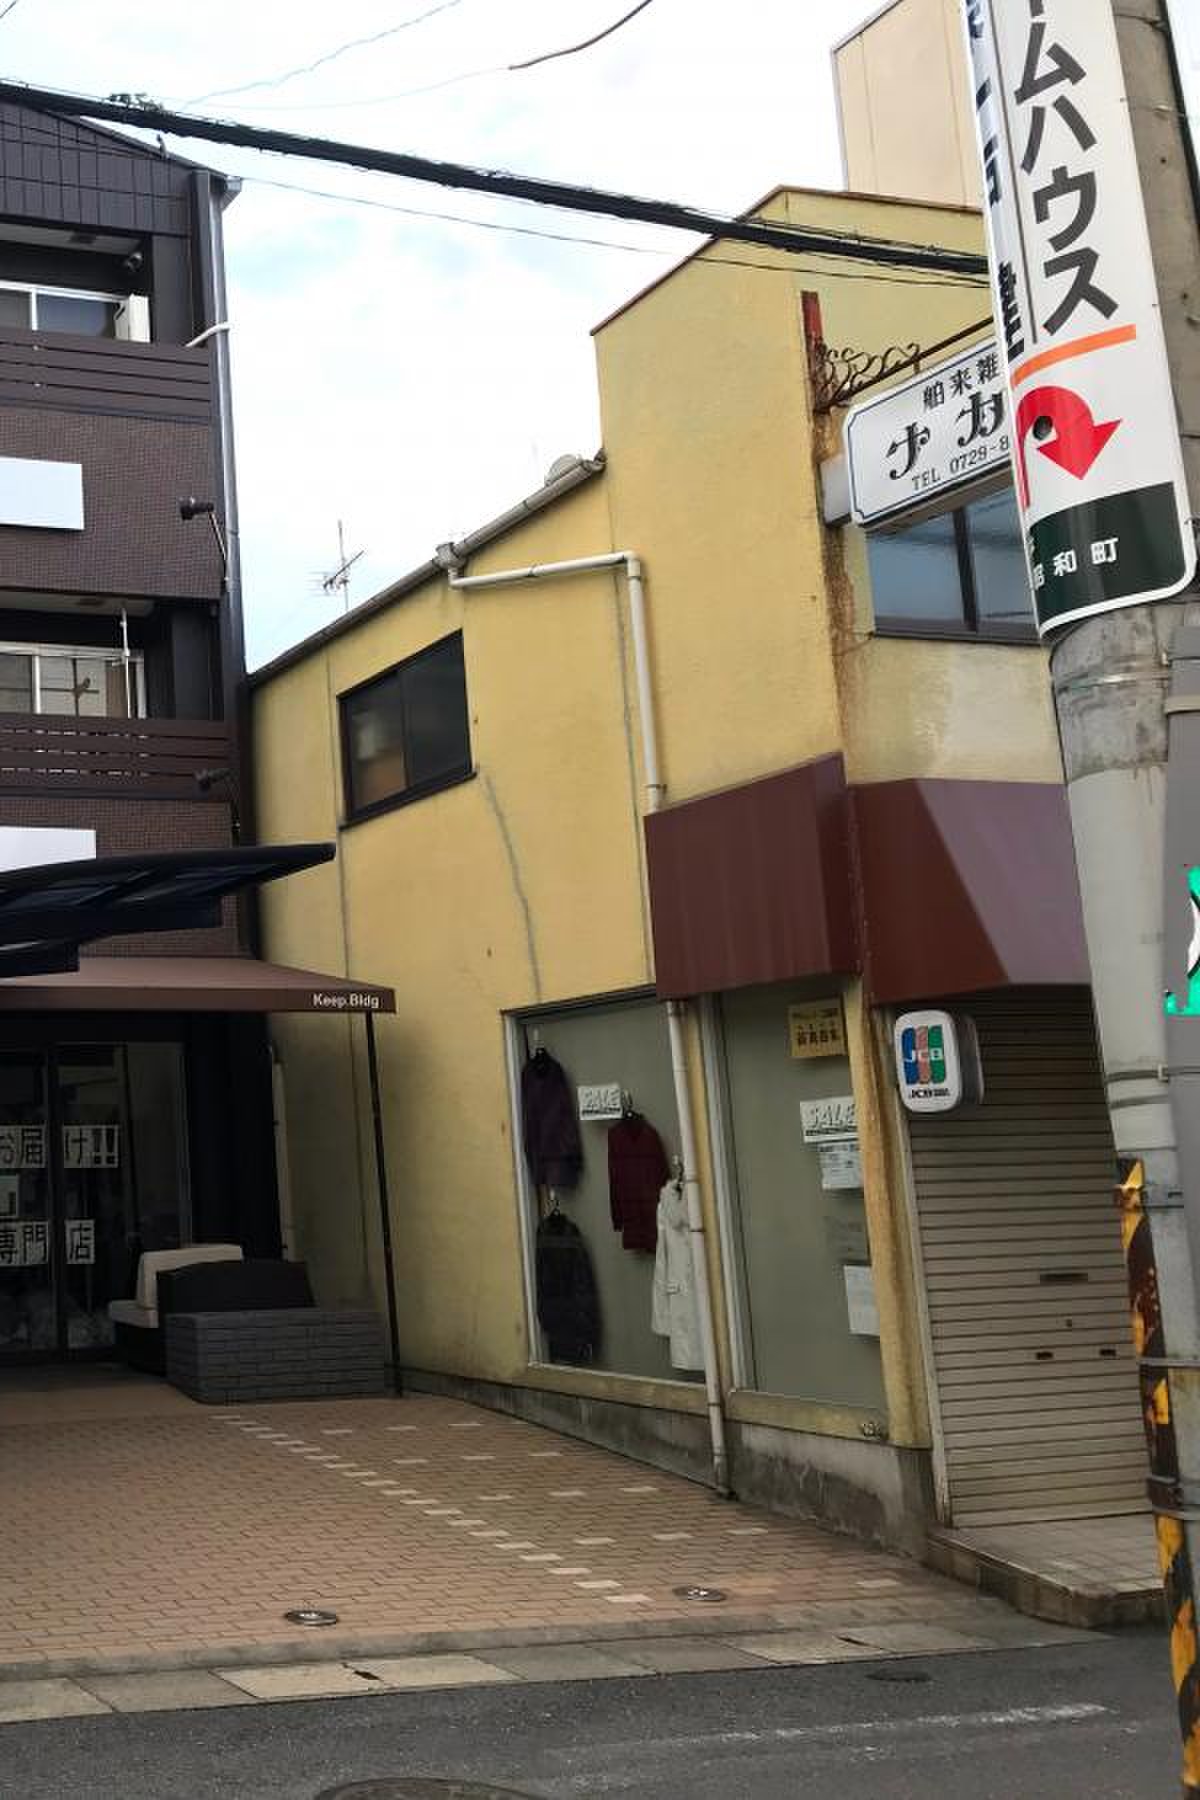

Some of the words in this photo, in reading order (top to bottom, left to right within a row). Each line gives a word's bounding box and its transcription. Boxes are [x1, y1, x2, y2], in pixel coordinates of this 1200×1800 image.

[1014, 0, 1119, 336] ムハウス
[912, 467, 941, 490] TEL
[312, 992, 379, 1009] Keep.Bldg
